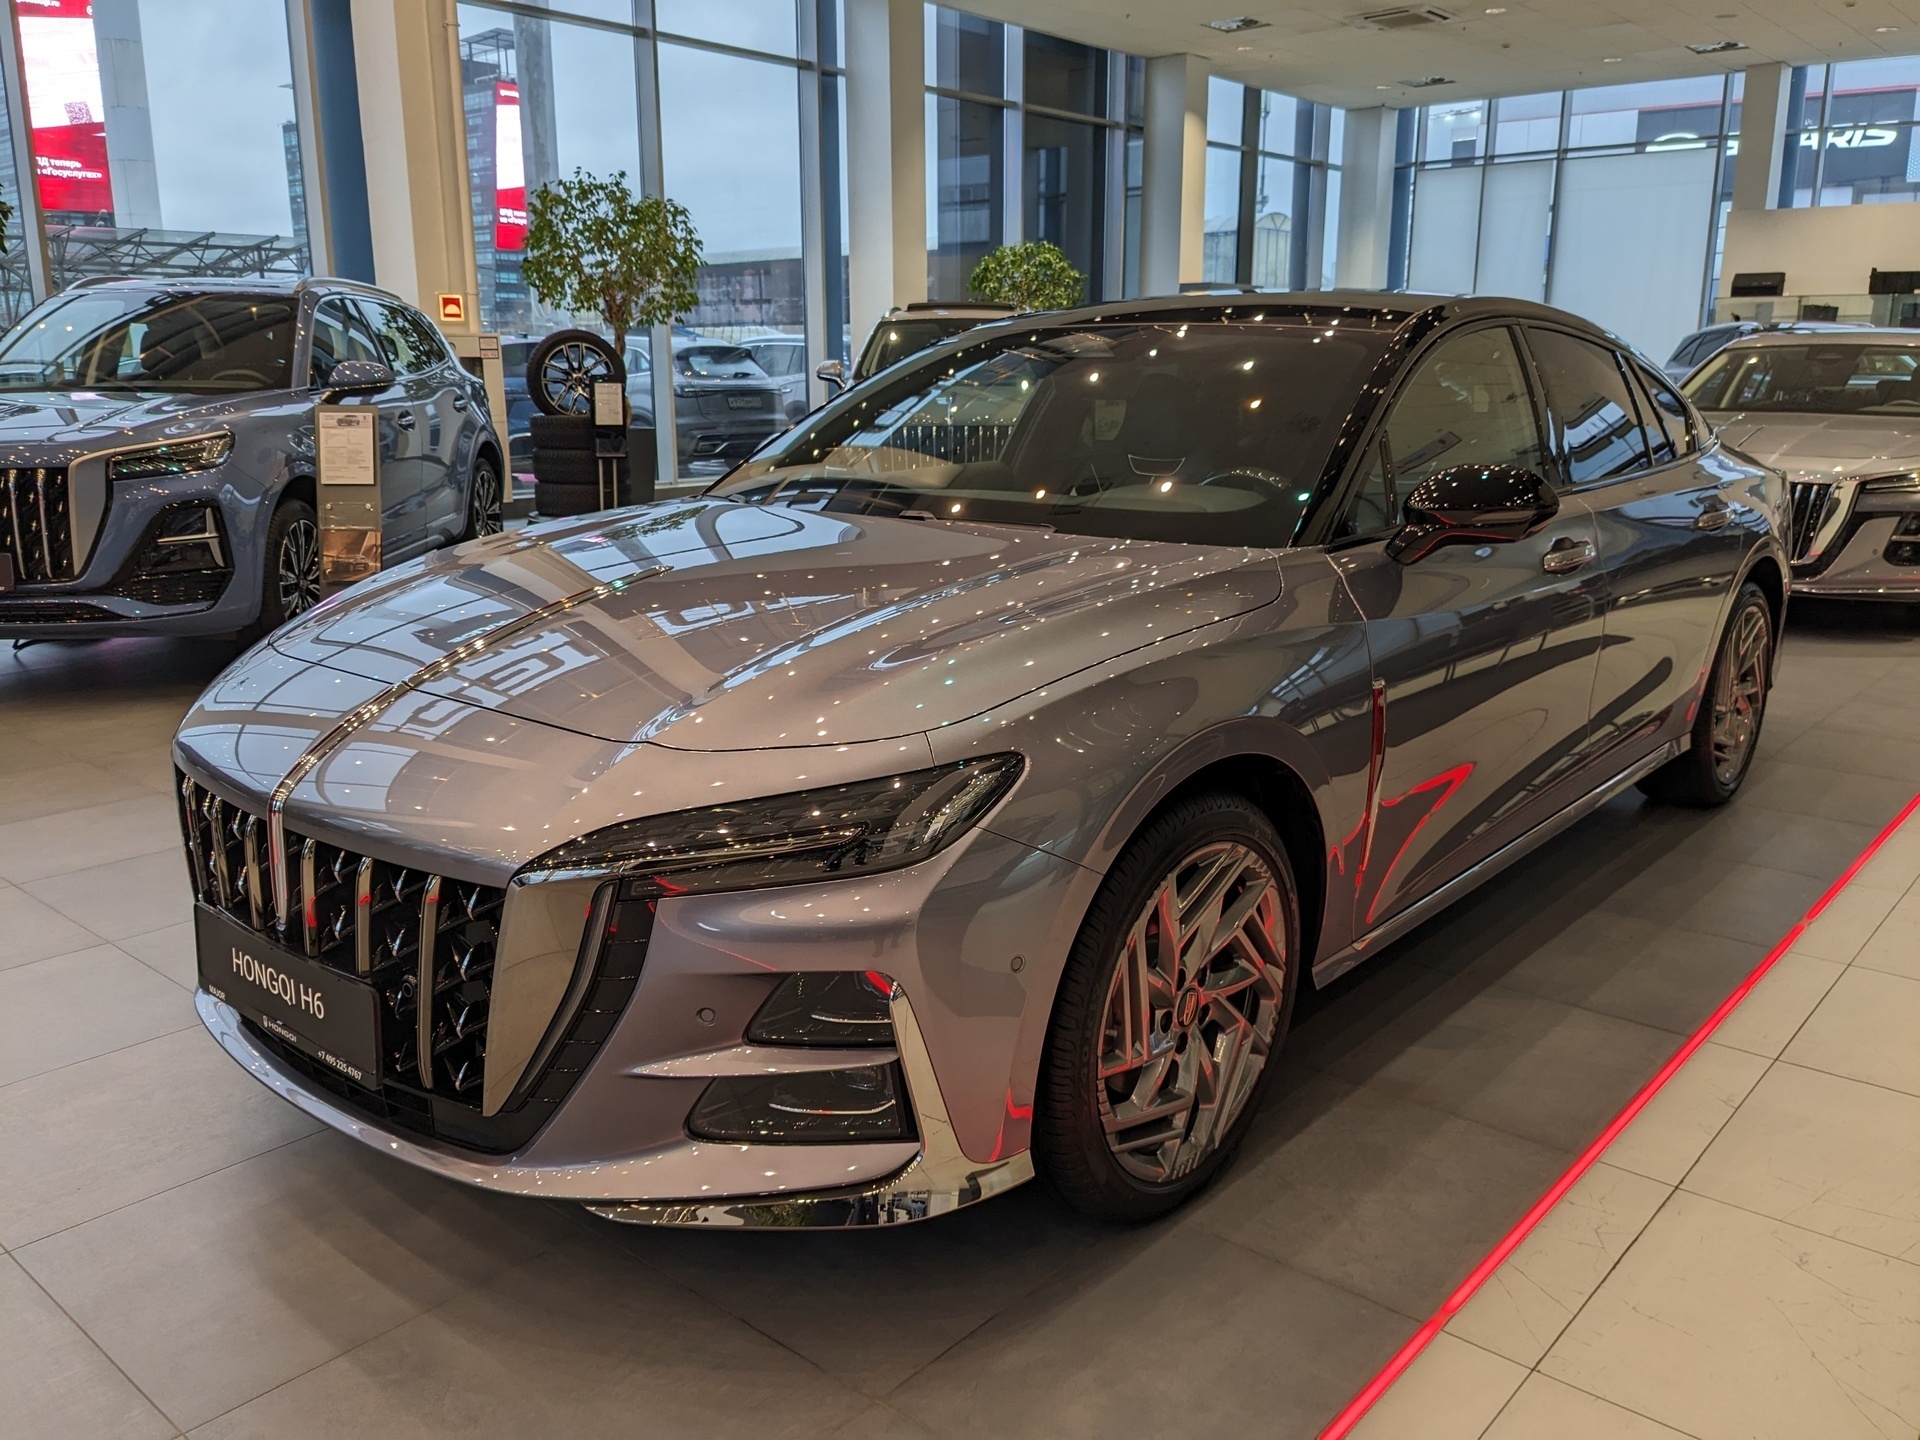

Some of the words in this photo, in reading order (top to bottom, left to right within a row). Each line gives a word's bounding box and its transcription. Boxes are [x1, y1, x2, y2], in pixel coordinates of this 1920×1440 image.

[50, 159, 82, 170] теперь
[208, 984, 226, 1001] MAJOR
[232, 947, 296, 1006] HONGQI
[300, 983, 325, 1020] H6
[268, 1021, 297, 1042] HONGQI
[317, 1050, 326, 1060] +7
[325, 1053, 337, 1066] 495
[336, 1059, 348, 1073] 225
[347, 1066, 362, 1080] 4767
